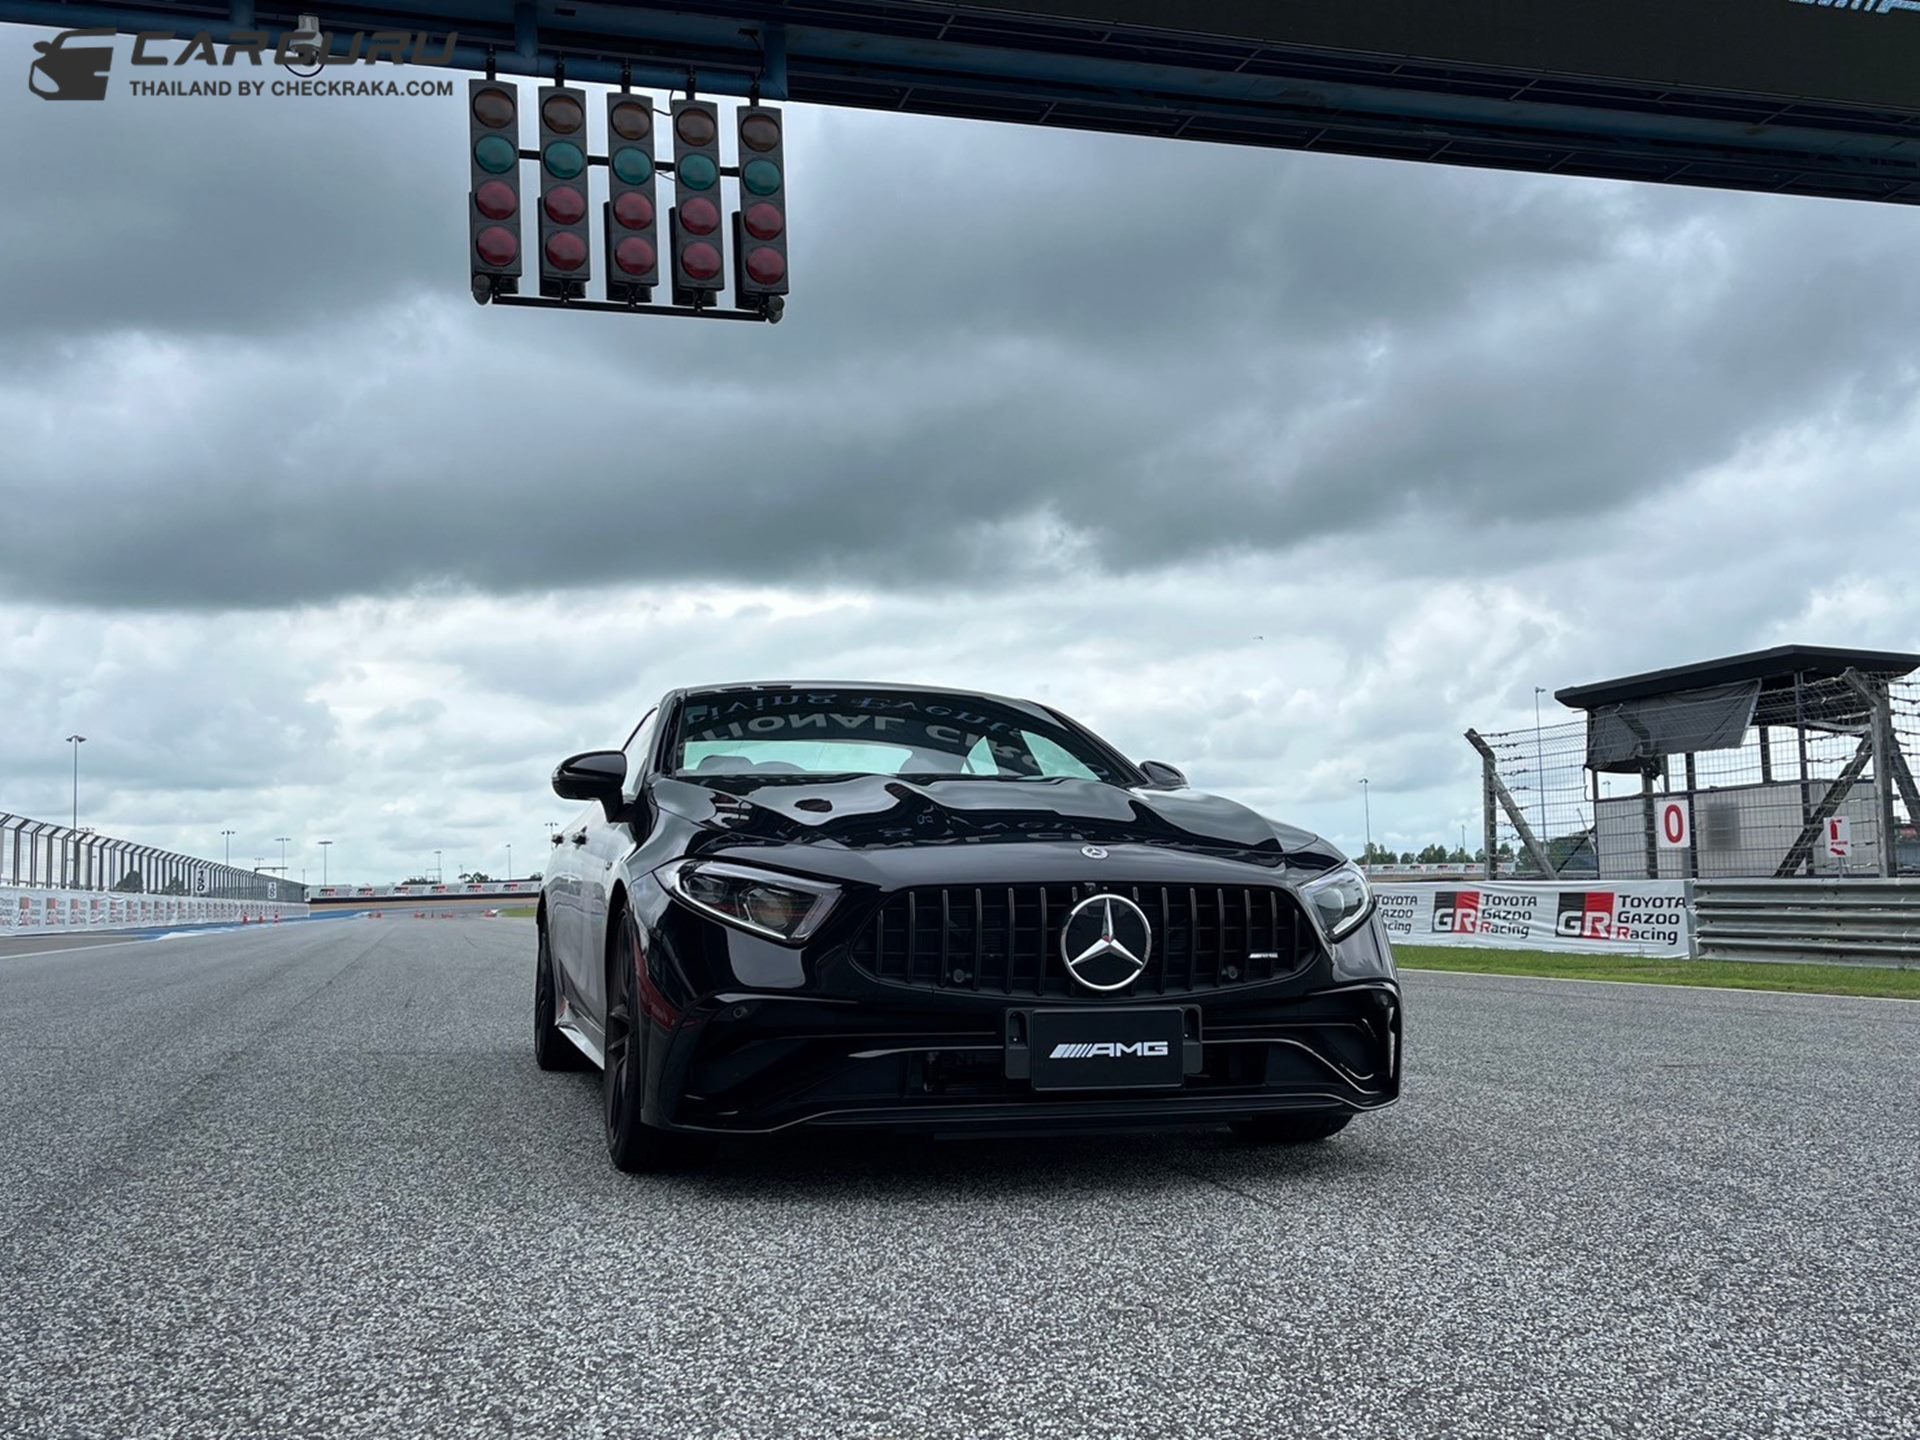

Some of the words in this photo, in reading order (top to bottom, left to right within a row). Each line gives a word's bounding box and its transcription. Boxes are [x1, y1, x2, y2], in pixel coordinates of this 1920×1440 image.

[1664, 804, 1684, 844] 0
[1482, 894, 1537, 906] TOYOTA
[1618, 895, 1687, 908] TOYOTA
[1378, 907, 1414, 919] AZOO
[1433, 907, 1477, 934] GR
[1481, 908, 1532, 921] GAZOO
[1617, 911, 1680, 925] GAZOO
[1481, 921, 1530, 939] Racing
[1557, 910, 1610, 938] GR
[1616, 927, 1678, 945] Racing
